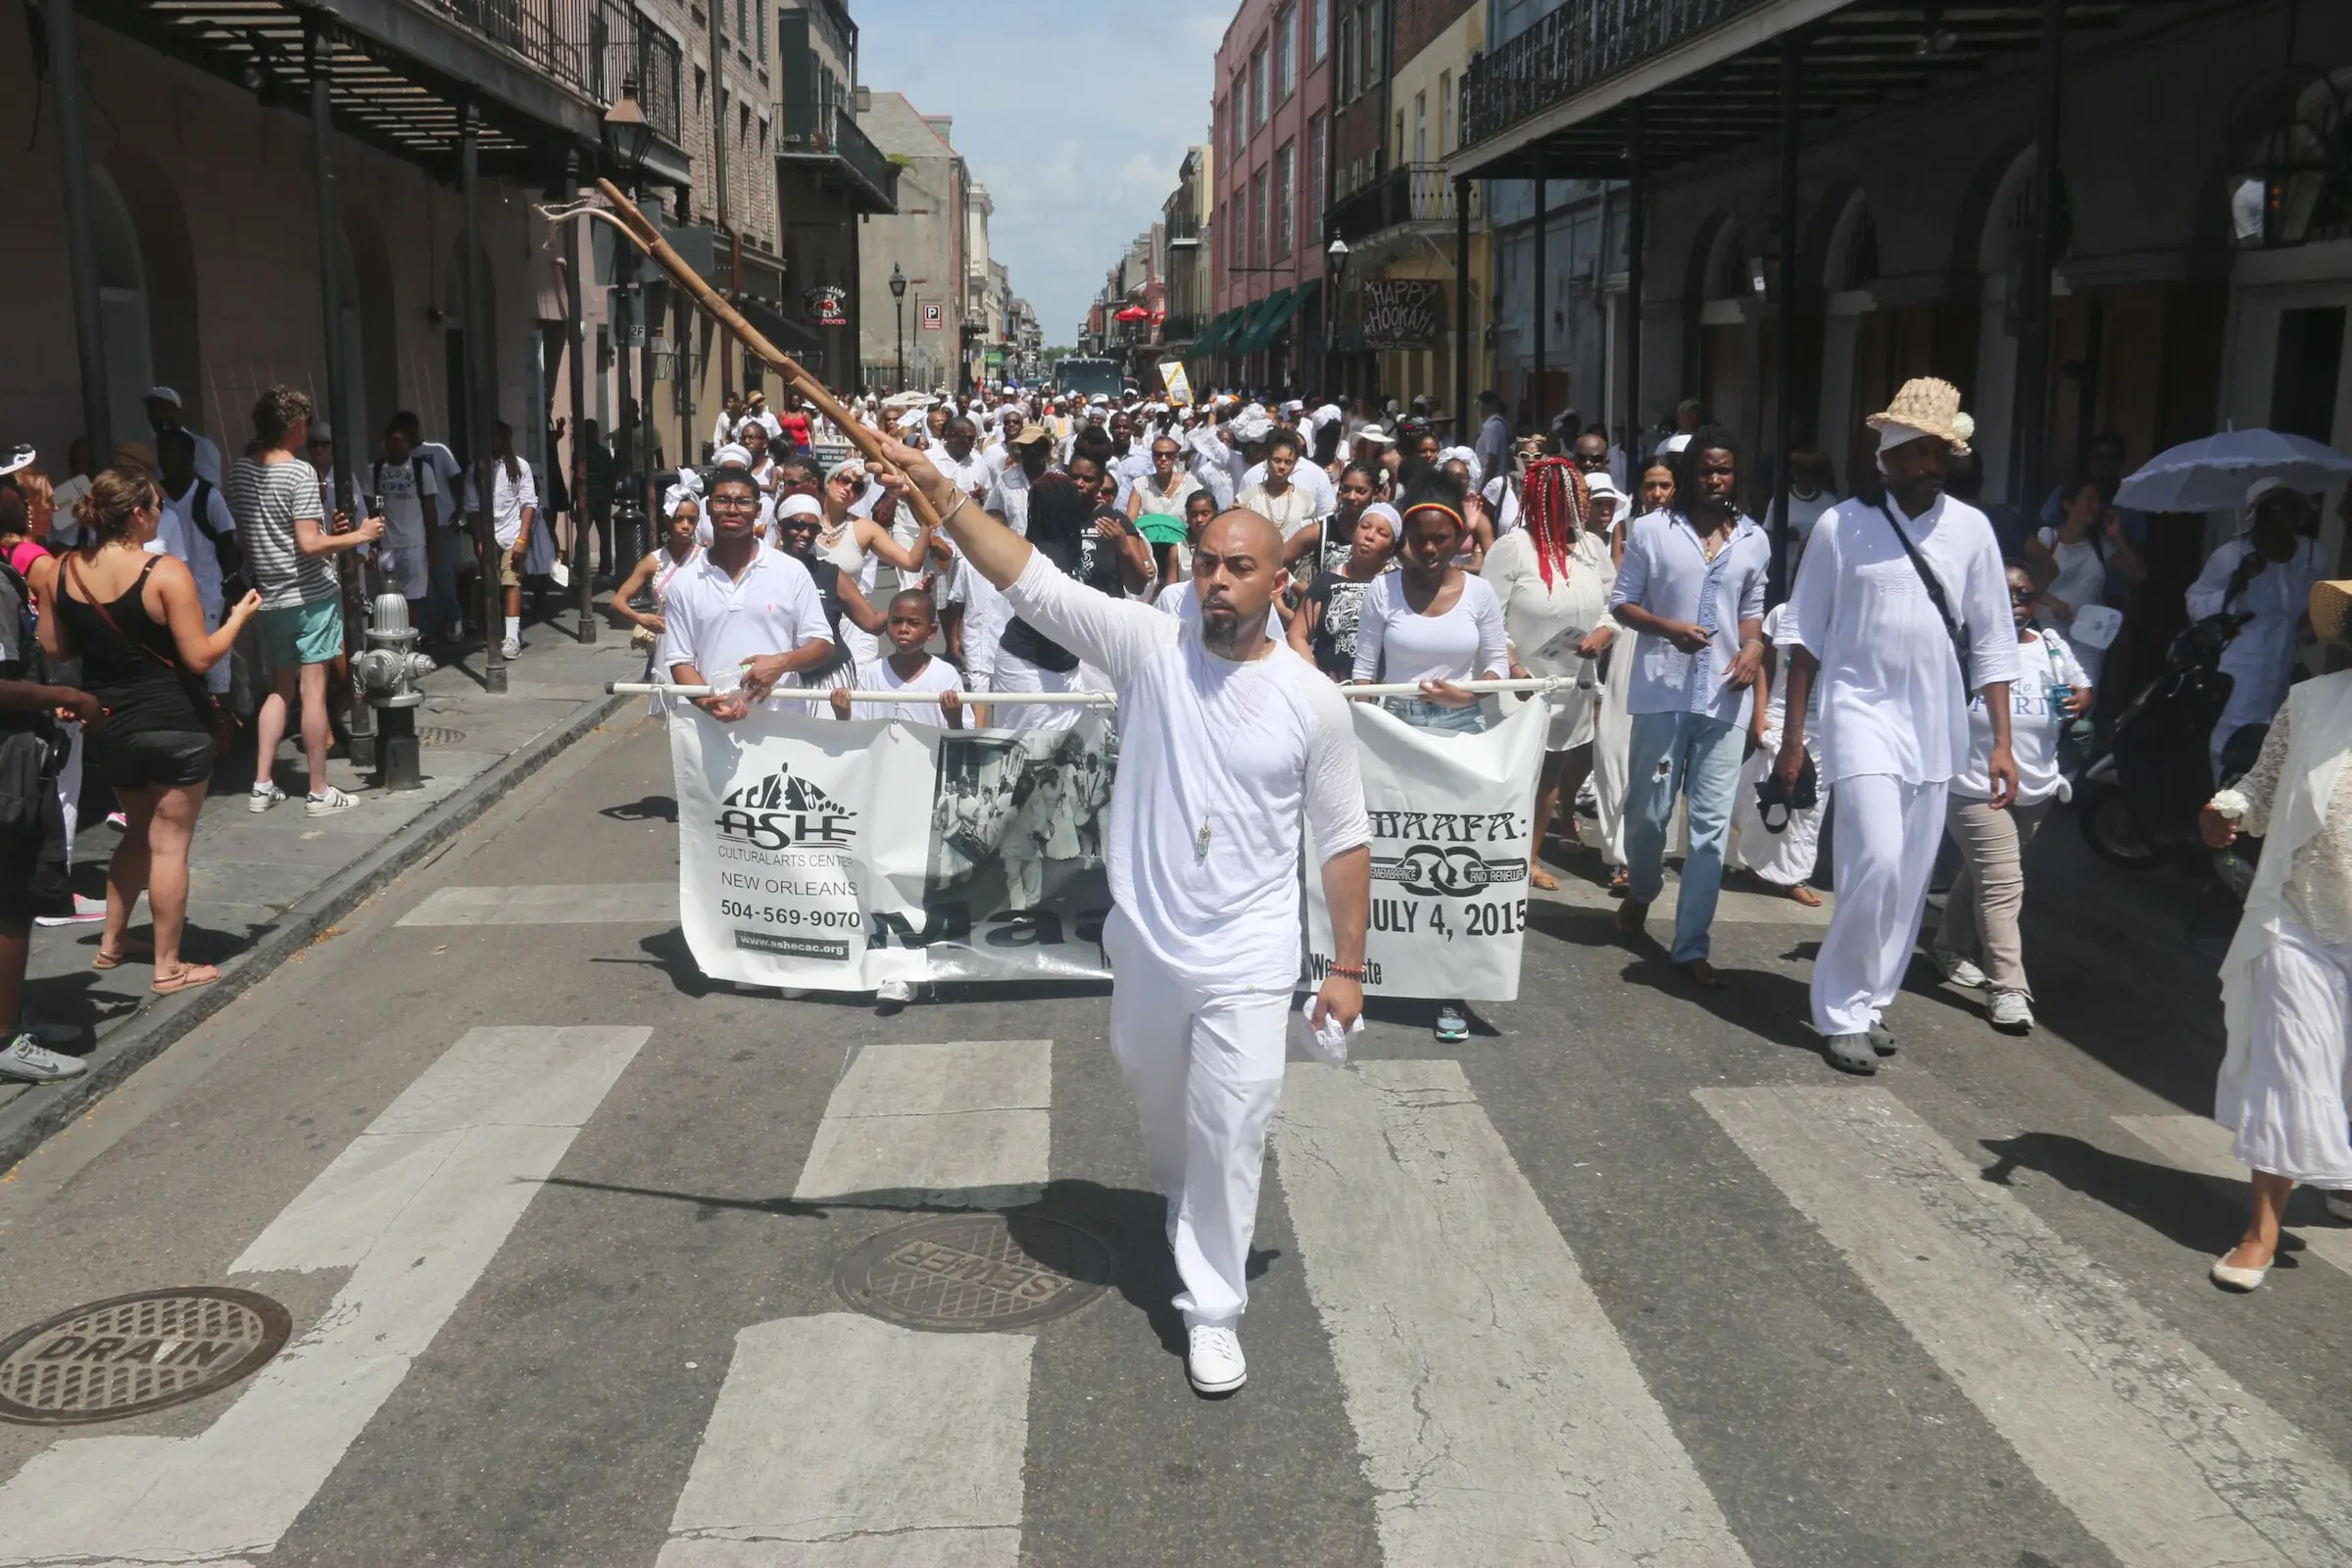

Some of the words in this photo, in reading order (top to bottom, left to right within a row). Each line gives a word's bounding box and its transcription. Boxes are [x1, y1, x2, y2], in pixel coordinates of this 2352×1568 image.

[1372, 281, 1436, 307] HAPPY
[927, 307, 937, 318] P
[1369, 306, 1433, 332] HOOKAH
[630, 326, 644, 336] 2F
[717, 845, 772, 865] CULTURAL
[773, 854, 806, 867] ARTS
[808, 855, 854, 867] CENTER
[721, 871, 760, 890] NEW
[765, 879, 858, 896] ORLEANS
[1370, 866, 1416, 881] EMEMBRANCE
[1470, 869, 1487, 882] AND
[721, 899, 860, 928] 504-569-9070
[1429, 904, 1453, 943] 4,
[1464, 899, 1526, 937] 2015
[739, 934, 845, 956] www.ashecac.org
[33, 1335, 235, 1367] DRAIN
